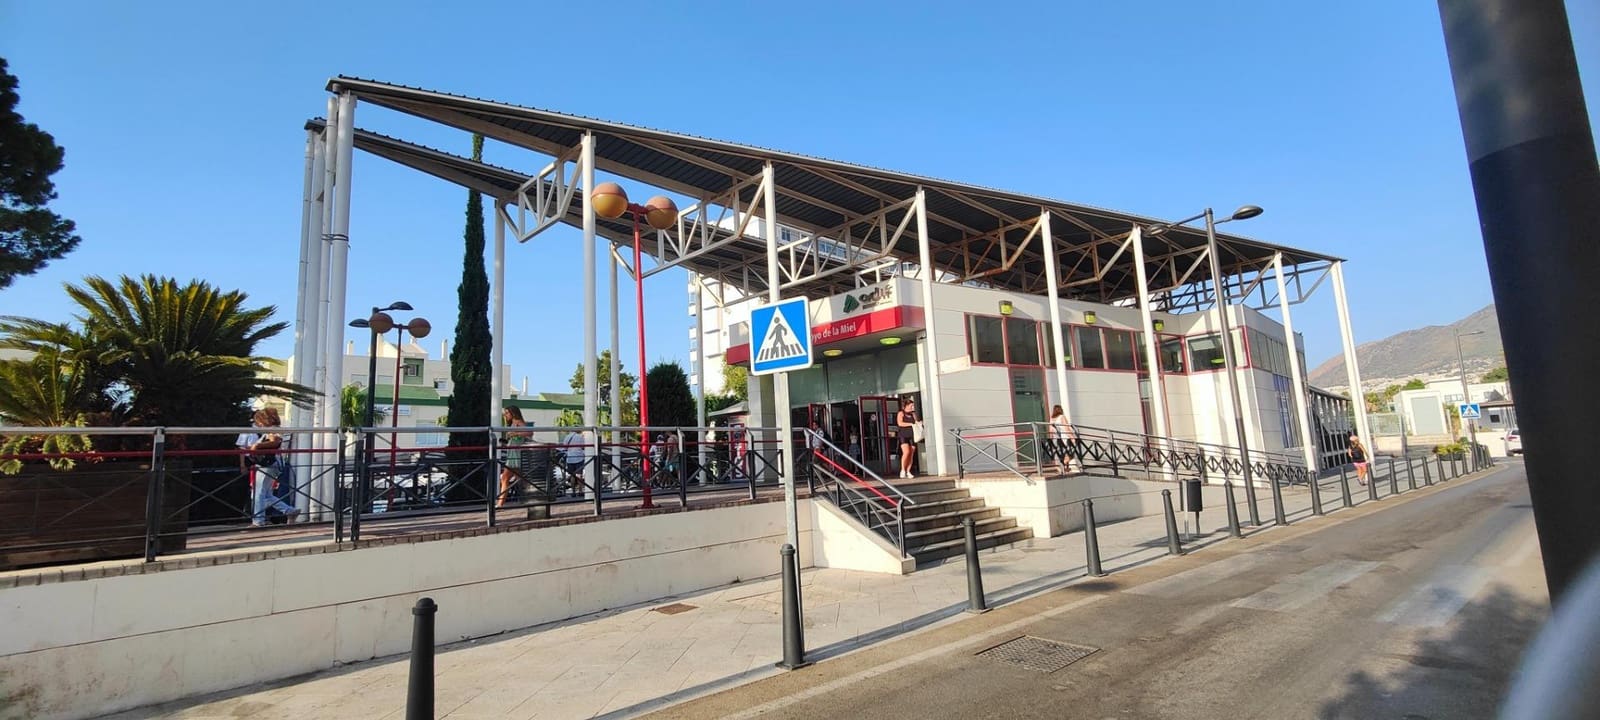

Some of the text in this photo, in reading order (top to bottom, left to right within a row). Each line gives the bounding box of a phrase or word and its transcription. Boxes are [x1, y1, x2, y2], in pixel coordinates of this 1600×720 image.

[823, 328, 832, 338] de
[832, 327, 839, 336] la
[840, 321, 856, 334] Miel
